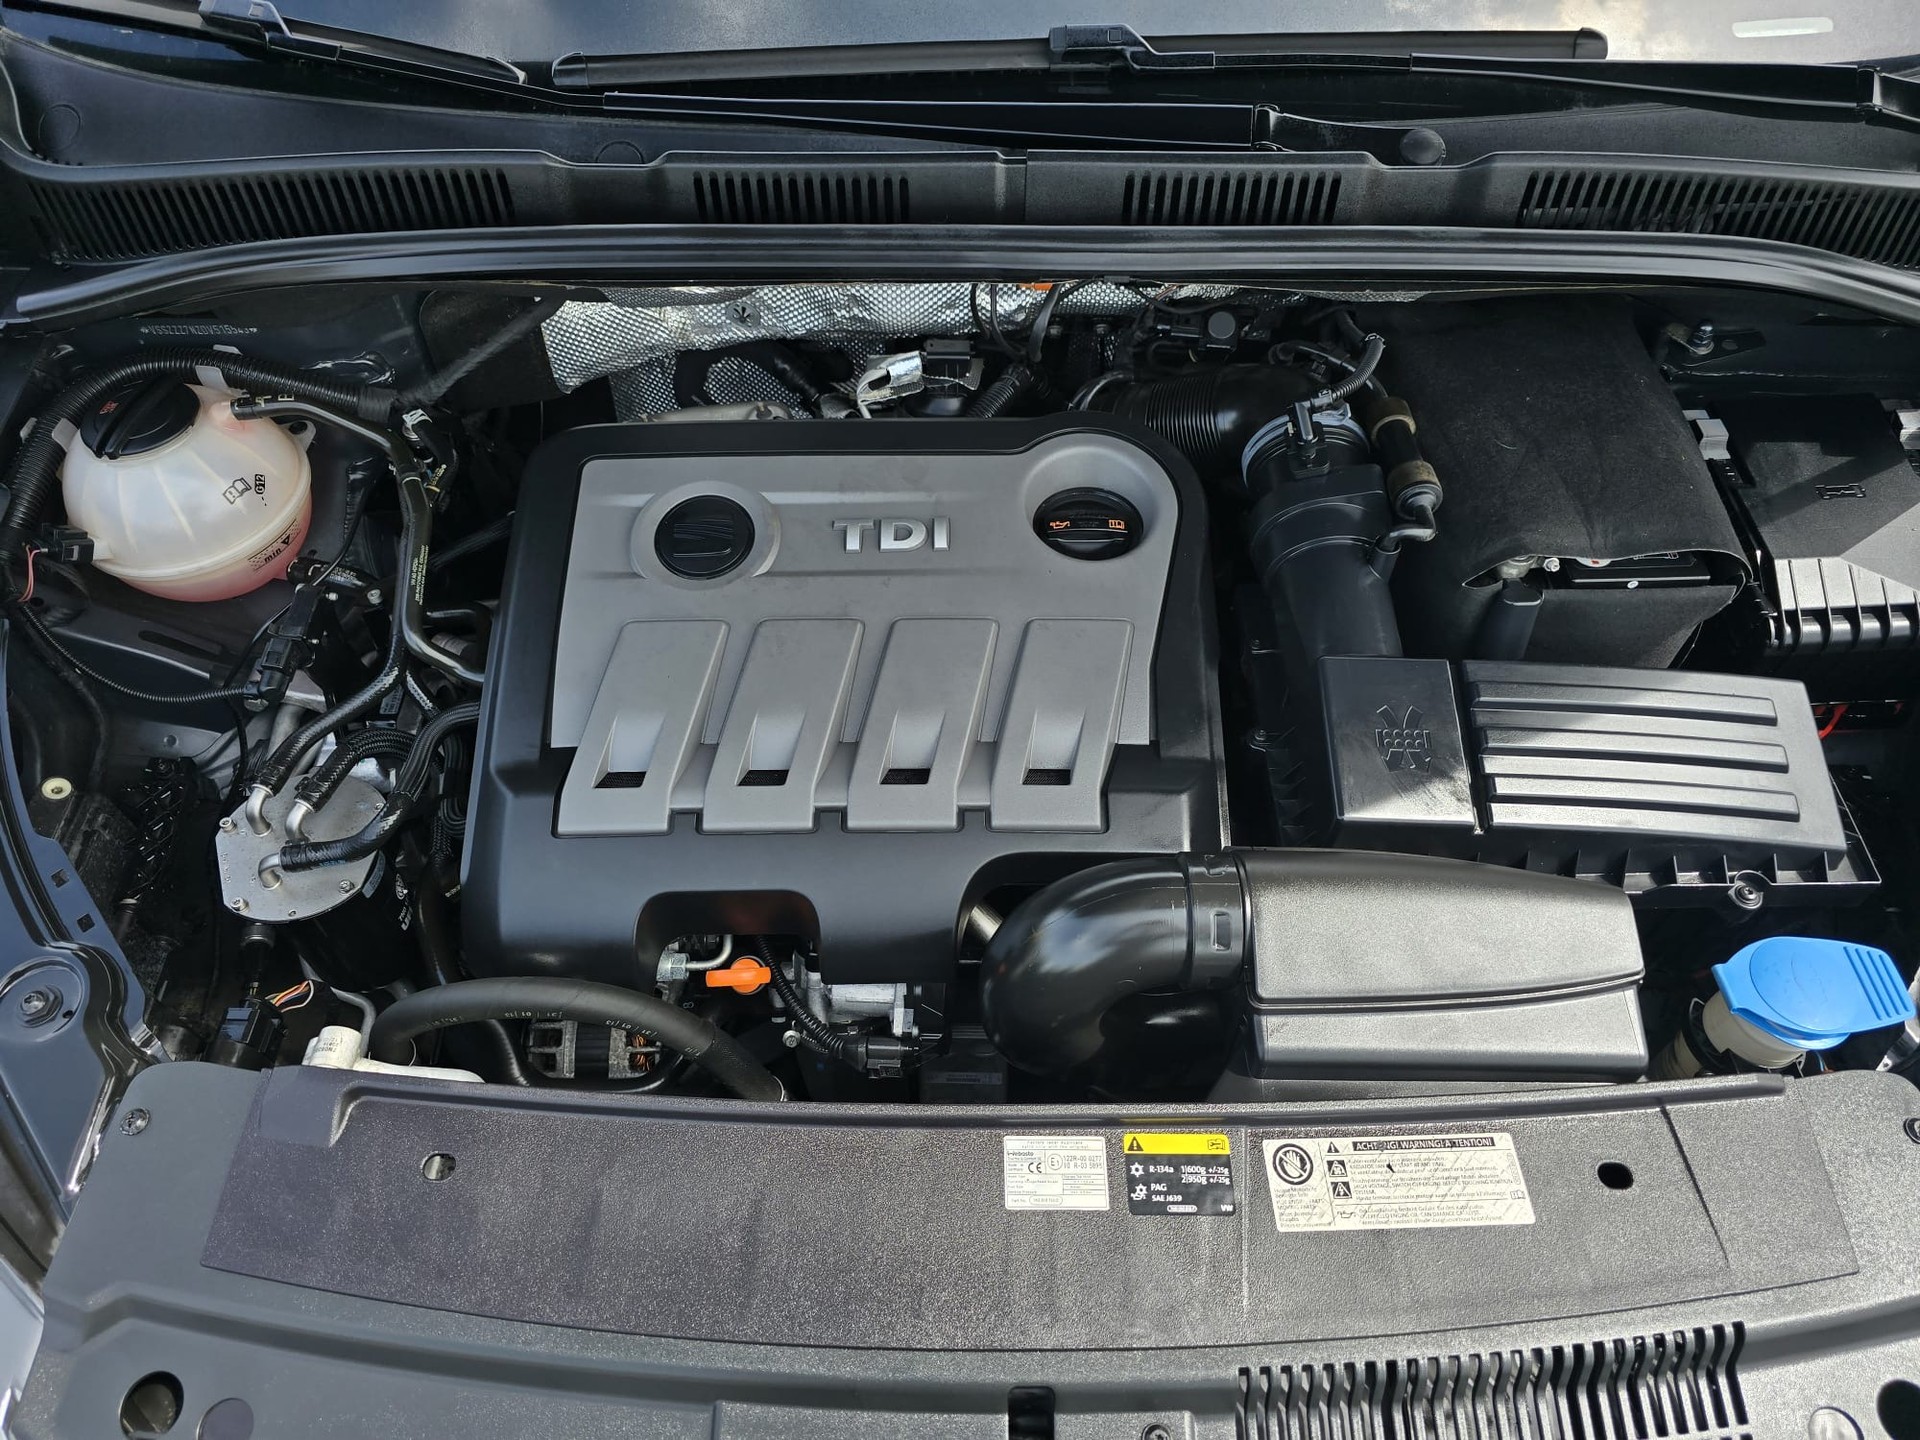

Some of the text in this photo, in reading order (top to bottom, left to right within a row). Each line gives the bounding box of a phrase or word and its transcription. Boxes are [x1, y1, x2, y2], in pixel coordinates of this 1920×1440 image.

[832, 516, 951, 554] TDI
[264, 547, 282, 565] min
[1356, 1137, 1492, 1150] ACHTNG! WARNING! ATENTION!
[1152, 1194, 1182, 1202] SAE J639
[1220, 1204, 1234, 1212] VW
